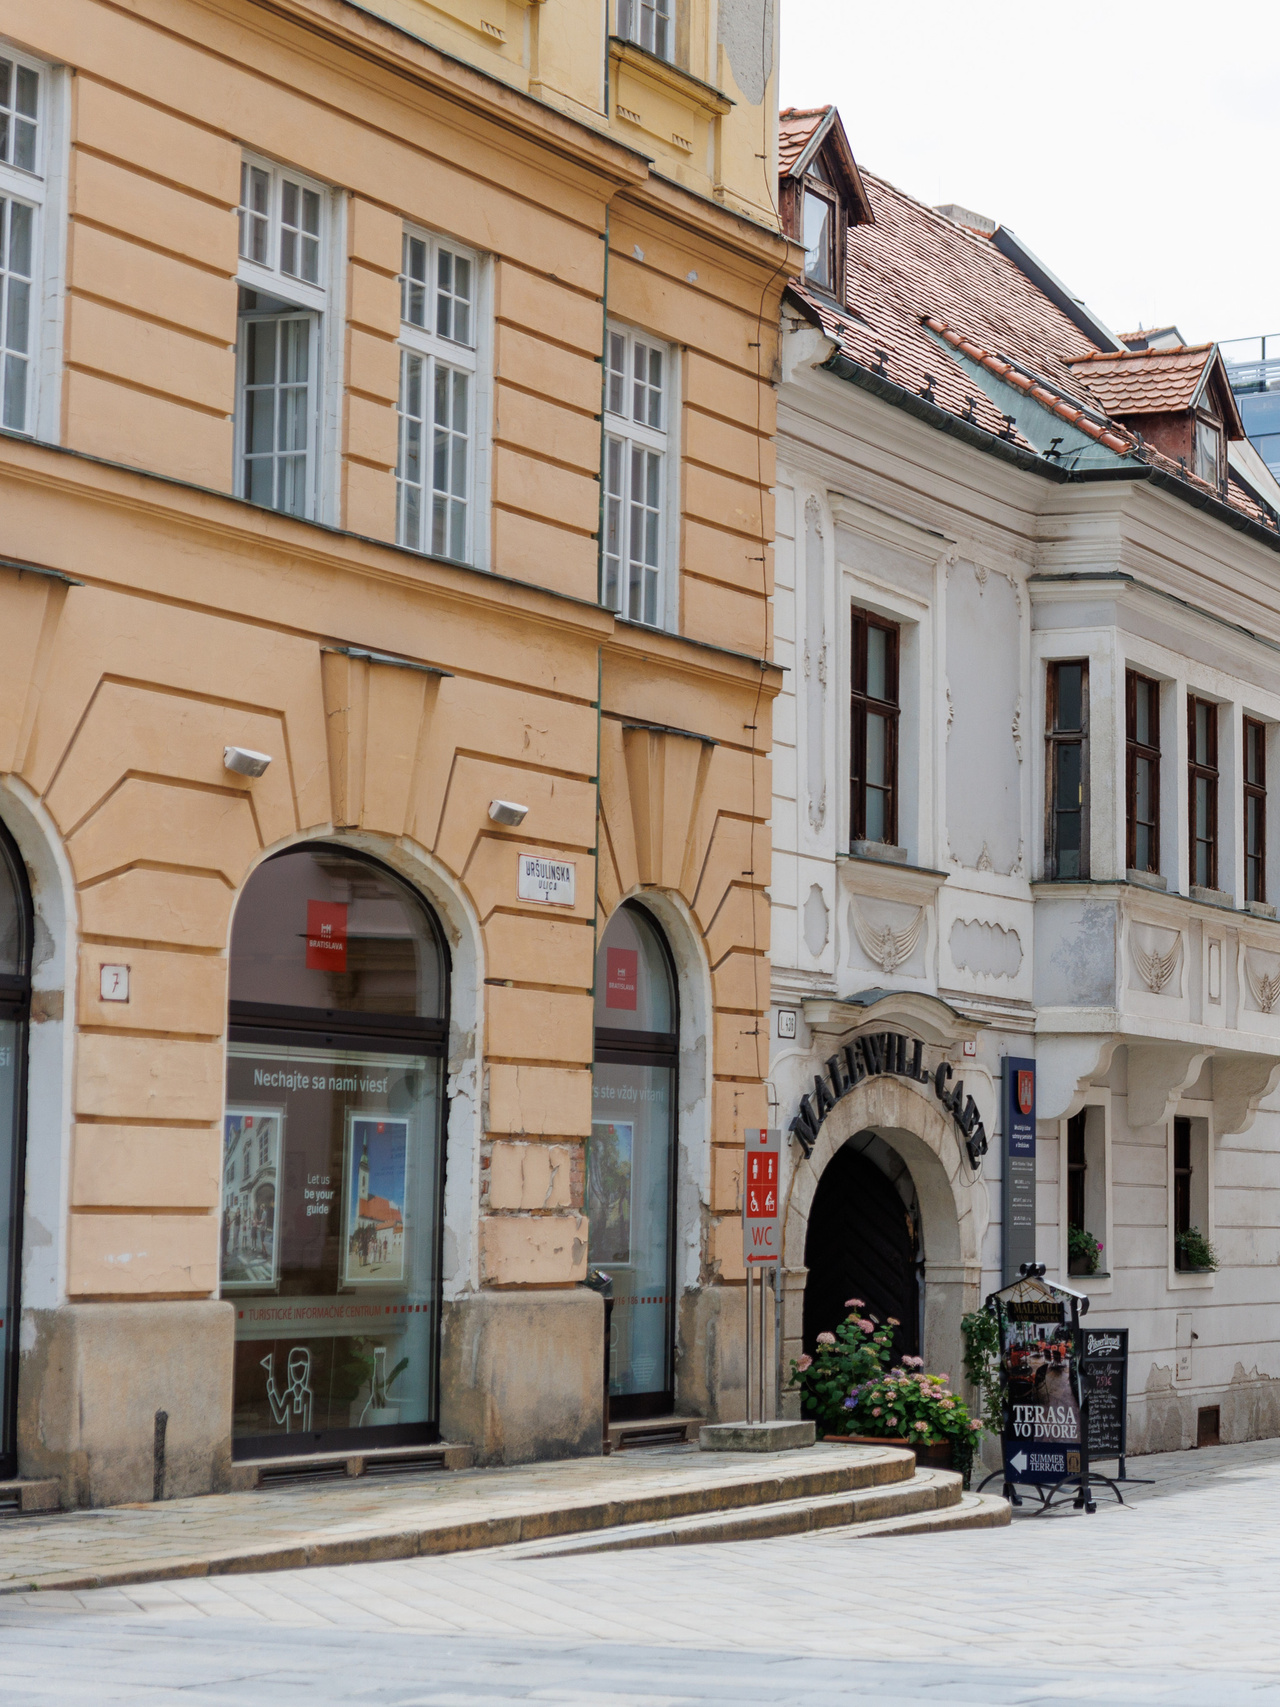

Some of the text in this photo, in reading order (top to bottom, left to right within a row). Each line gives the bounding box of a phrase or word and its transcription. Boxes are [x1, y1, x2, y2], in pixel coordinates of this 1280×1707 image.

[525, 859, 571, 883] URŠULÍNSKA
[538, 880, 557, 891] ULICA
[309, 939, 343, 951] BRATISLAVA
[112, 972, 119, 993] 7
[608, 982, 634, 991] BRATISLAVA
[253, 1068, 389, 1094] Nechajte sa nami viesť
[600, 1085, 615, 1099] ste
[617, 1084, 638, 1104] vždy
[787, 1032, 929, 1160] MALEWILL
[307, 1173, 330, 1185] Let us
[304, 1188, 334, 1202] be your
[306, 1203, 329, 1217] guide
[751, 1226, 773, 1246] WC
[249, 1304, 382, 1321] TURISTICKÉ INFORMAČNÉ CENTRUM
[1013, 1303, 1062, 1315] MALEWILL
[1012, 1405, 1077, 1425] TERASA
[1013, 1423, 1031, 1438] VO
[1034, 1423, 1078, 1439] DVORE
[1029, 1453, 1064, 1464] SUMMER
[1029, 1462, 1065, 1472] TERRACE
